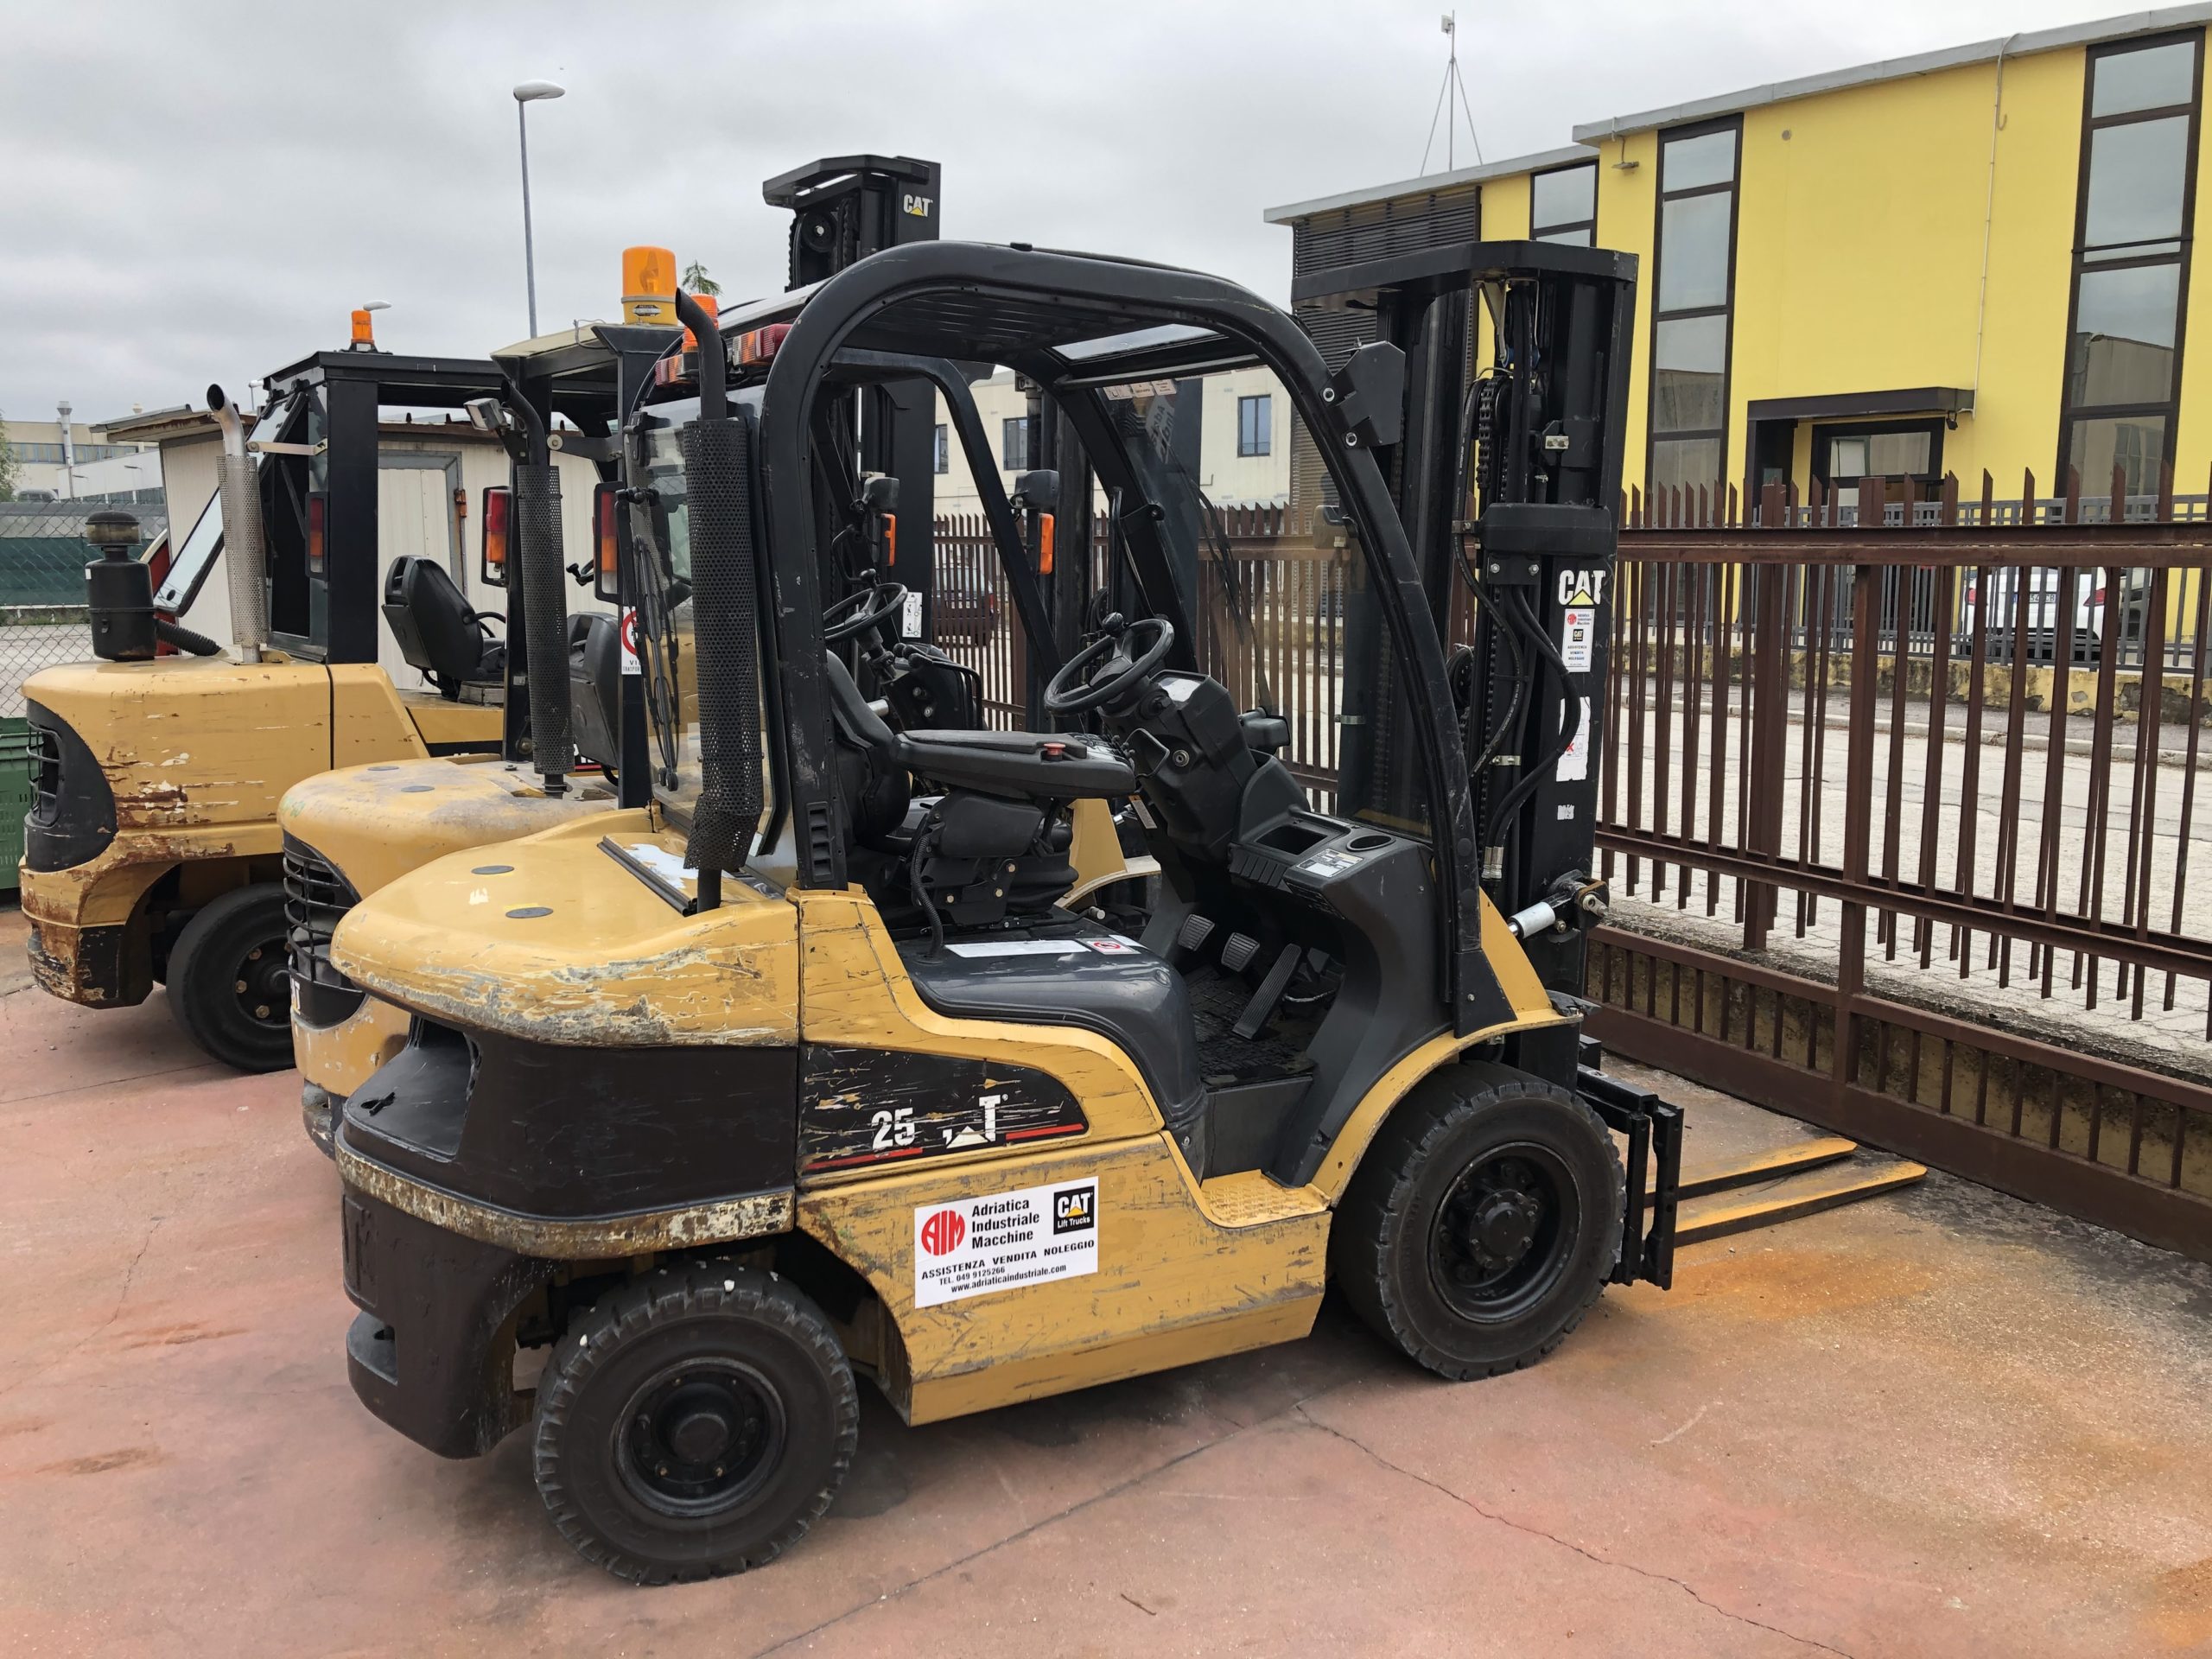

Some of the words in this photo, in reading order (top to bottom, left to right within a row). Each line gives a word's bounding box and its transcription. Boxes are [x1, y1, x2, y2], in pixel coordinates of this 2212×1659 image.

[903, 194, 931, 217] CAT
[1559, 570, 1605, 605] CAT
[872, 1107, 916, 1150] 25
[972, 1199, 1029, 1217] Adriatica
[1058, 1192, 1091, 1218] CAT
[921, 1210, 966, 1255] AIM
[972, 1212, 1039, 1233] Industriale
[1058, 1218, 1068, 1229] Lift
[1070, 1216, 1090, 1225] Trucks
[972, 1230, 1033, 1249] Macchine
[922, 1260, 985, 1280] ASSISTENZA
[993, 1251, 1037, 1265] VENDITA
[1044, 1240, 1095, 1256] NOLEGGIO
[939, 1277, 954, 1286] TEL.
[957, 1273, 969, 1281] 049
[951, 1264, 1066, 1293] www.adriaticaindustriale.com
